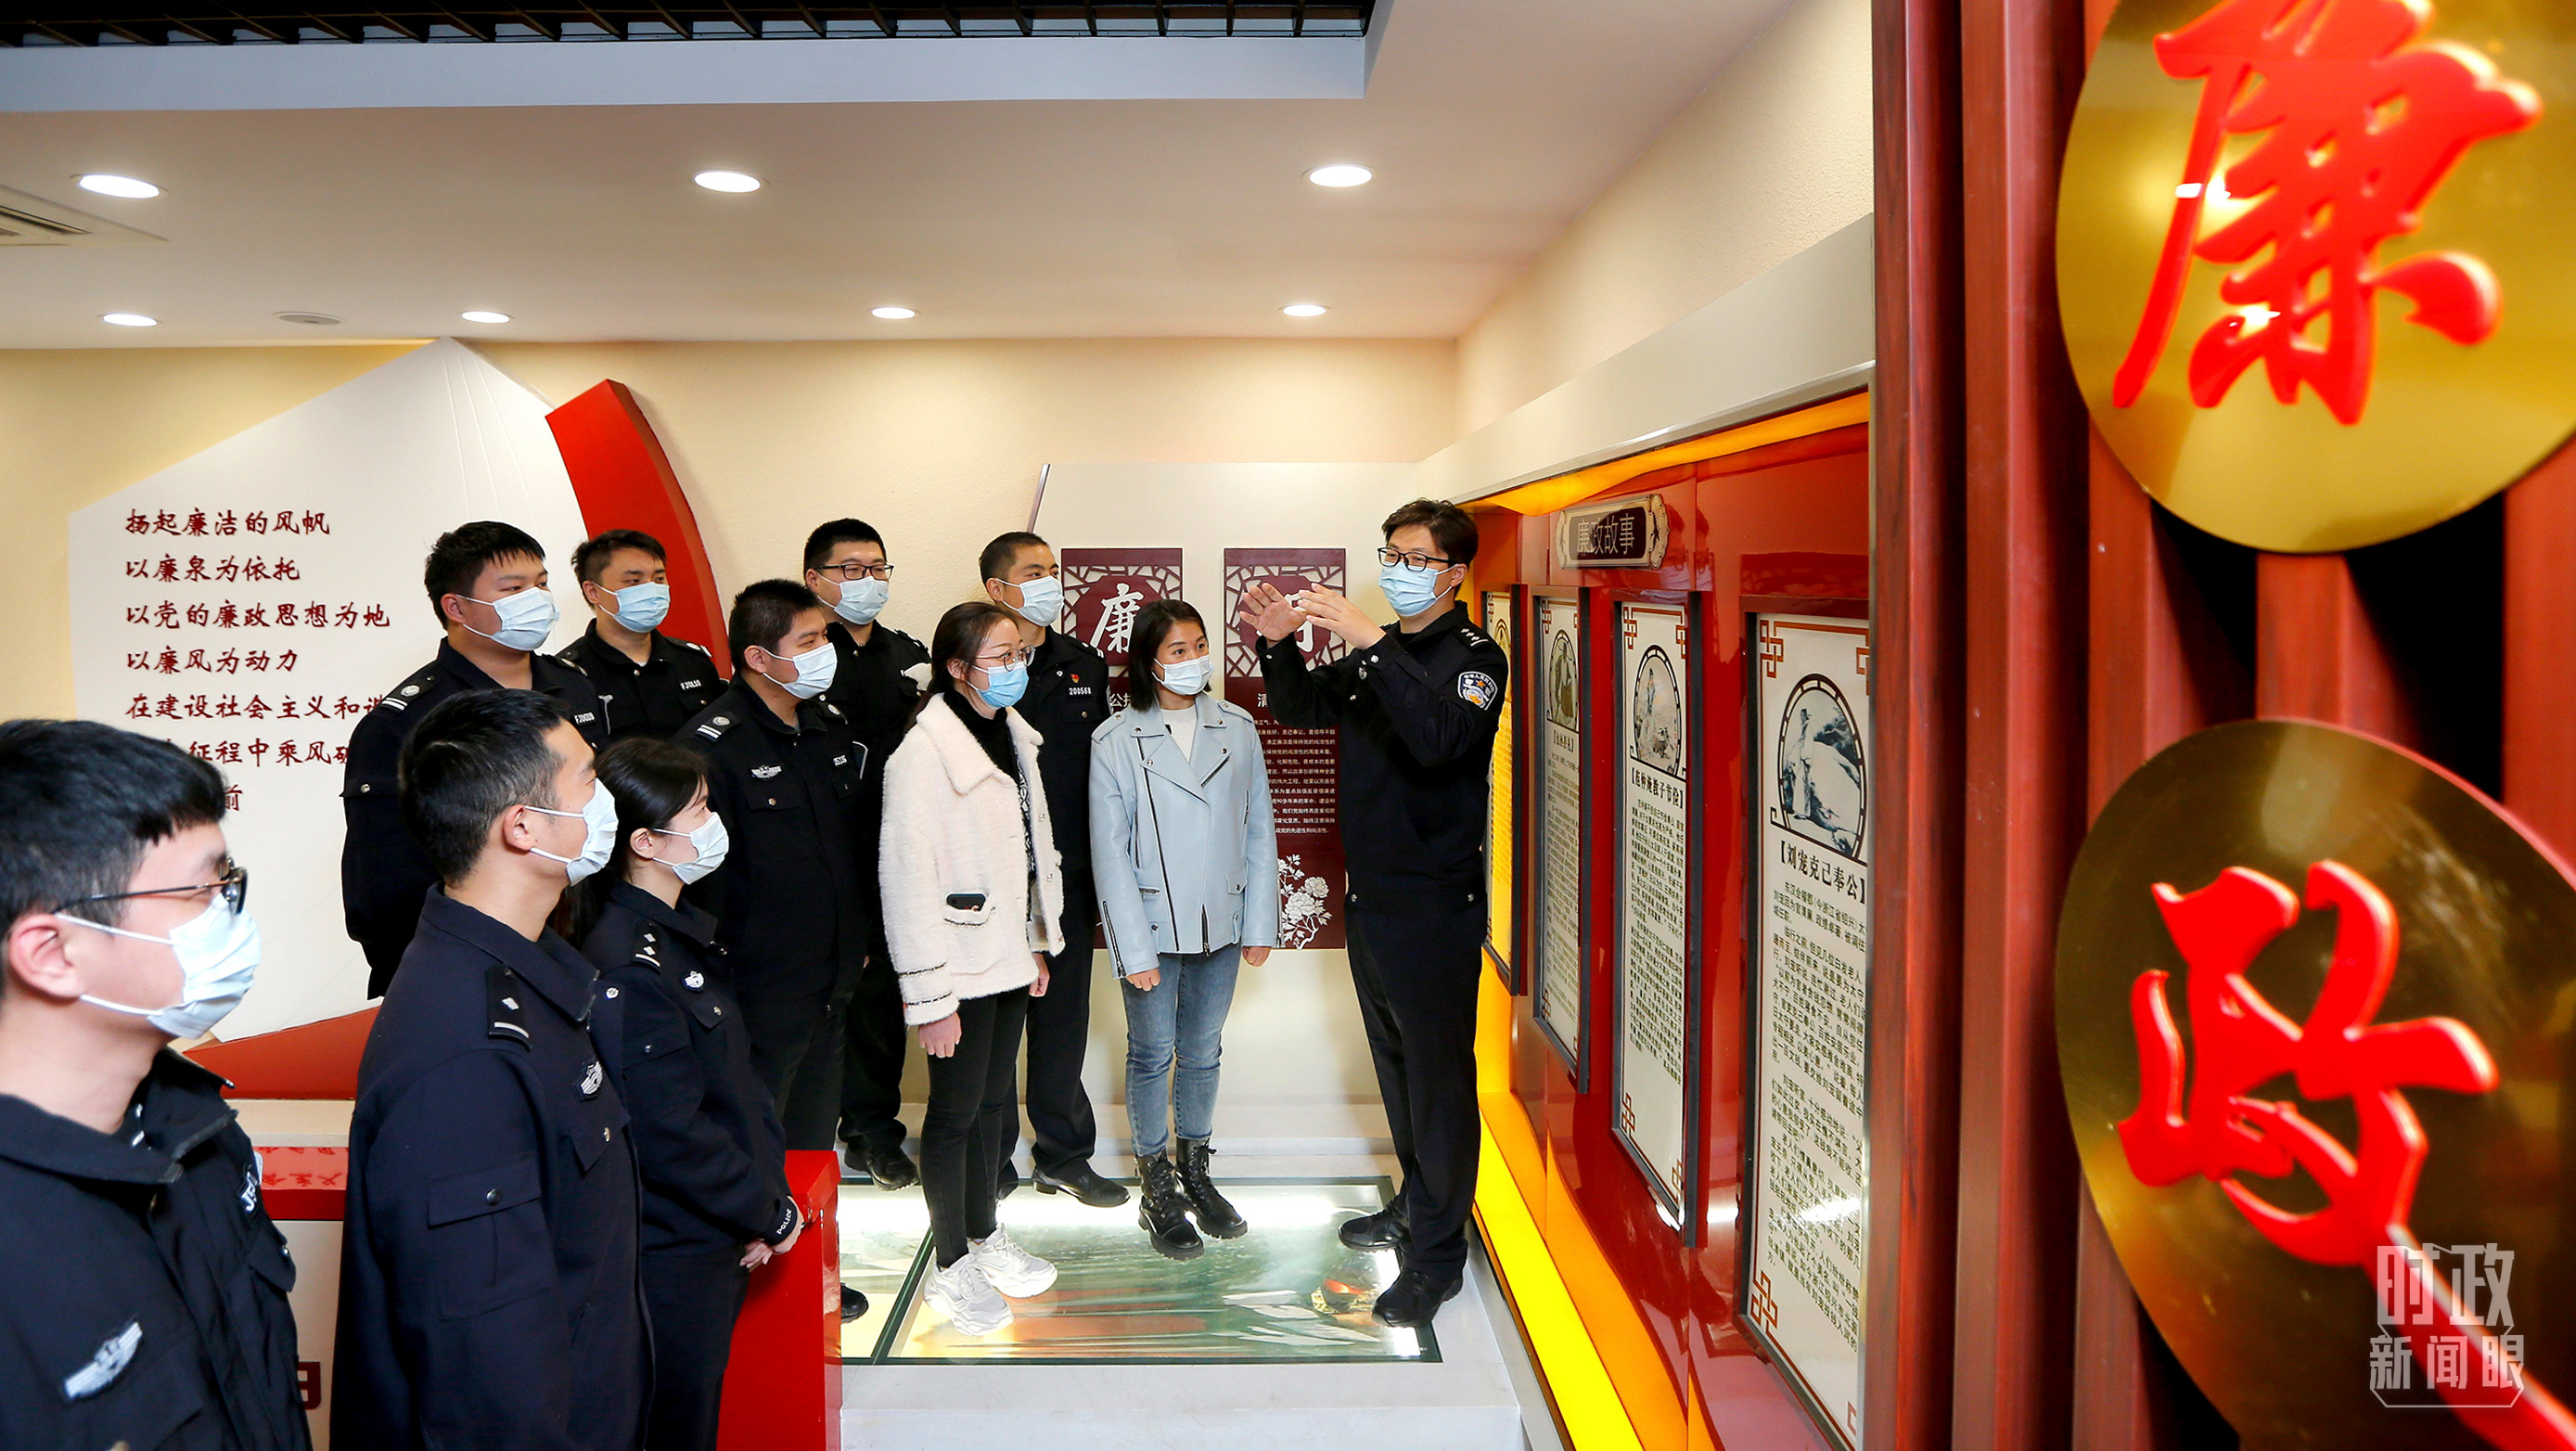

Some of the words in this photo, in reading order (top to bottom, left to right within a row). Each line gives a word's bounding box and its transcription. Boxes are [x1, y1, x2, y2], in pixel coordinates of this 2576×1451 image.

[125, 507, 330, 537] 扬起廉洁的风帆
[1577, 513, 1635, 555] 廉政故事
[125, 553, 301, 583] 以廉泉为依托
[126, 599, 391, 629] 以党的廉政思想为地
[126, 645, 298, 674] 以廉风为动力
[1781, 840, 1865, 905] 【刘宠克己奉公】
